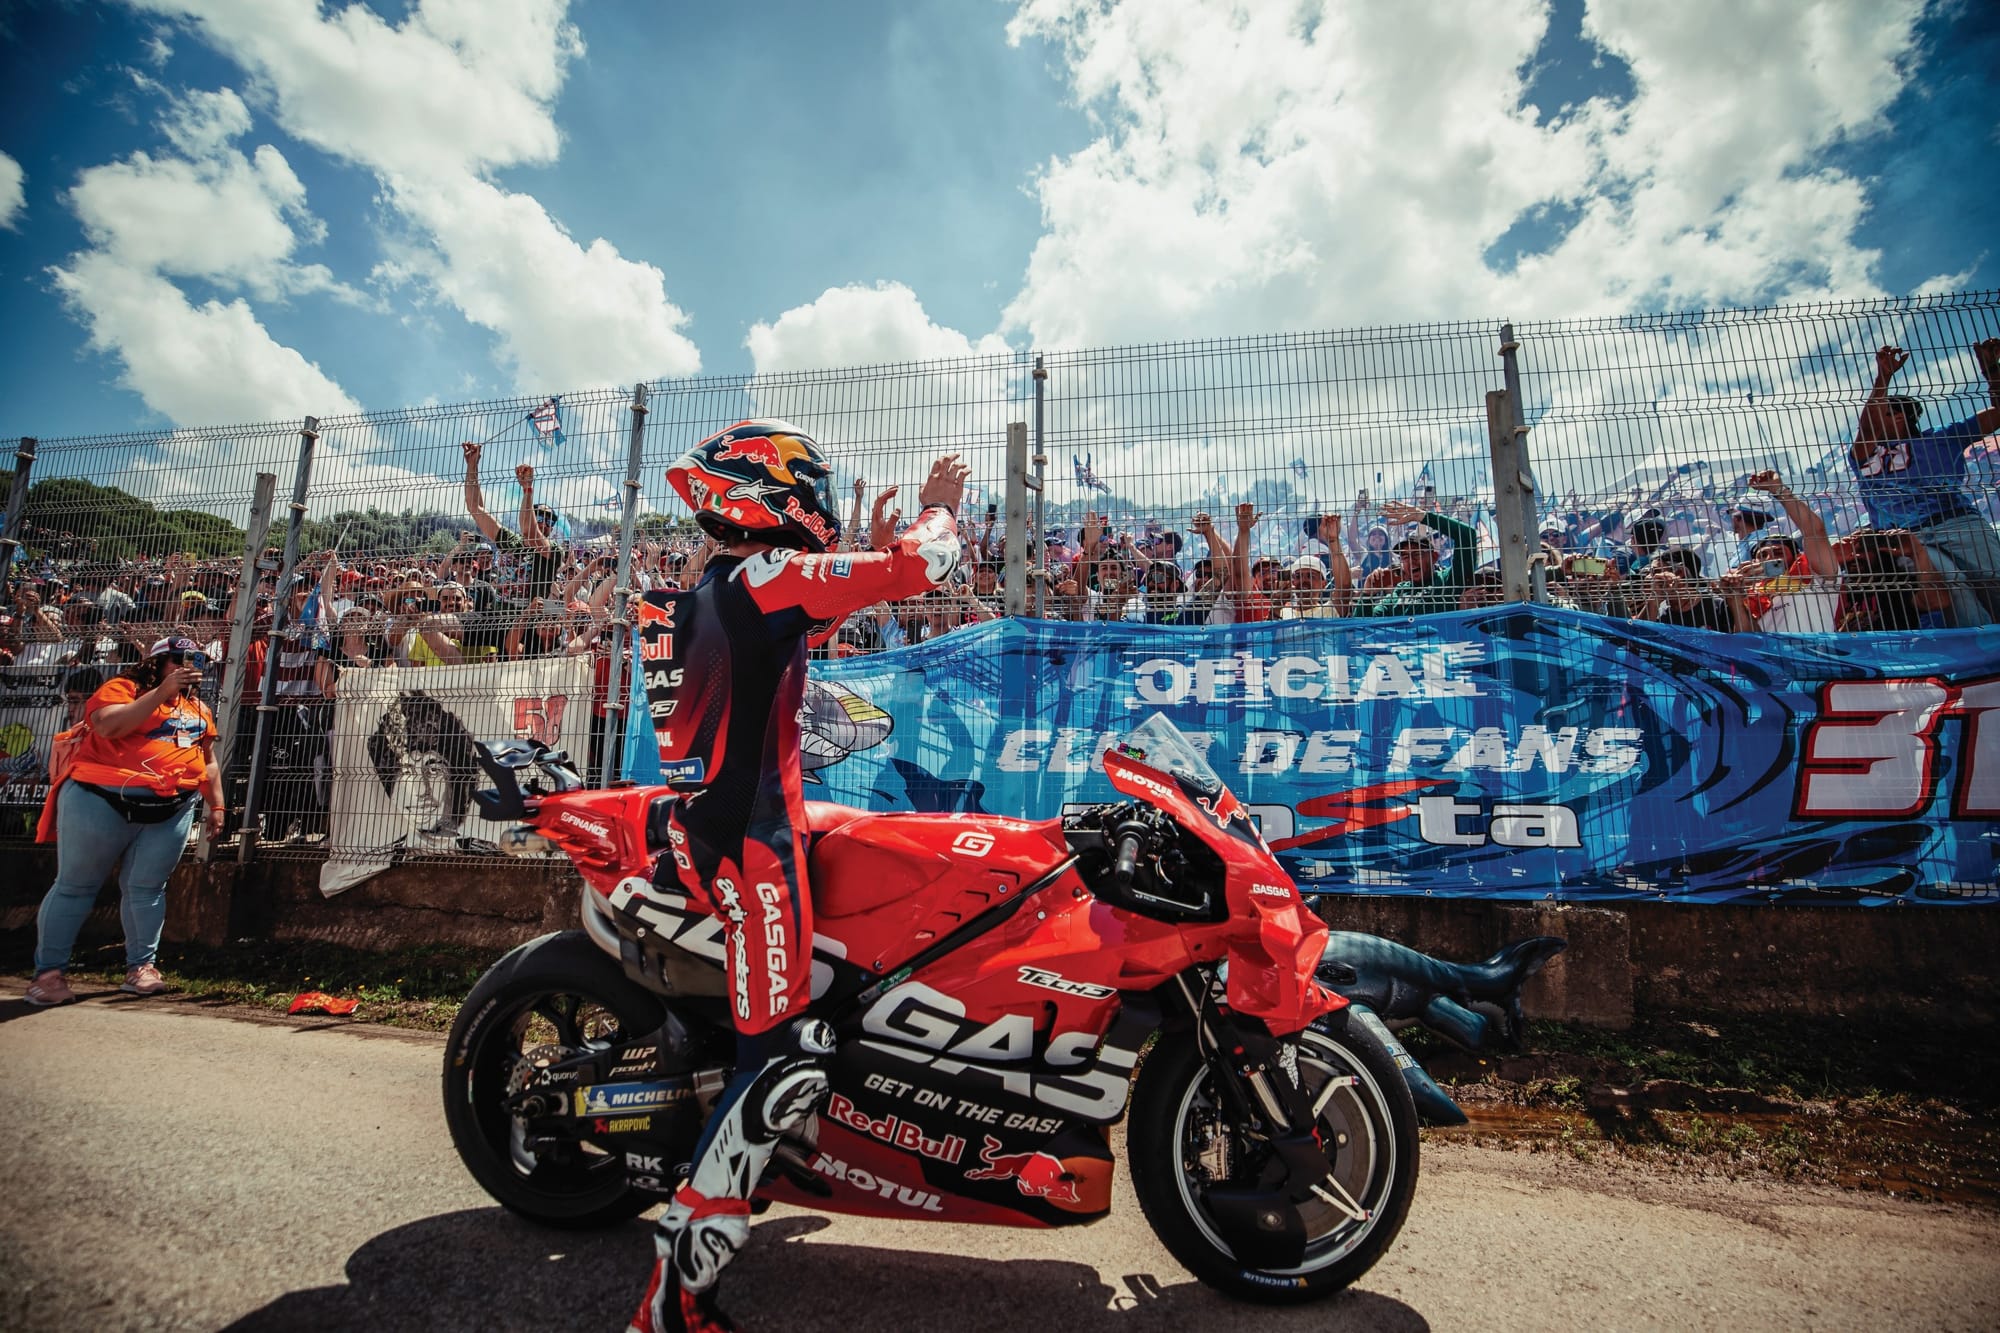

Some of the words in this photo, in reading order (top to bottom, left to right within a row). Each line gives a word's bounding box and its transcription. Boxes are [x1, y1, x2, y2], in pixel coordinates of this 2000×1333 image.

[639, 634, 673, 660] Bull
[1130, 643, 1488, 704] OFICIAL
[1238, 730, 1361, 773] DE
[1387, 725, 1645, 773] FANS
[1115, 767, 1175, 798] MOTUL
[1252, 883, 1291, 898] GASGAS
[756, 882, 789, 1017] GASGAS
[1017, 966, 1117, 999] TECH3
[859, 981, 1138, 1120] GAS
[827, 1092, 898, 1142] Red
[894, 1120, 967, 1165] Bull
[864, 1073, 914, 1098] GET
[913, 1088, 952, 1111] ON
[955, 1100, 1003, 1124] THE
[1004, 1113, 1064, 1134] GAS!
[625, 1151, 664, 1172] RK
[812, 1152, 944, 1212] MOTUL
